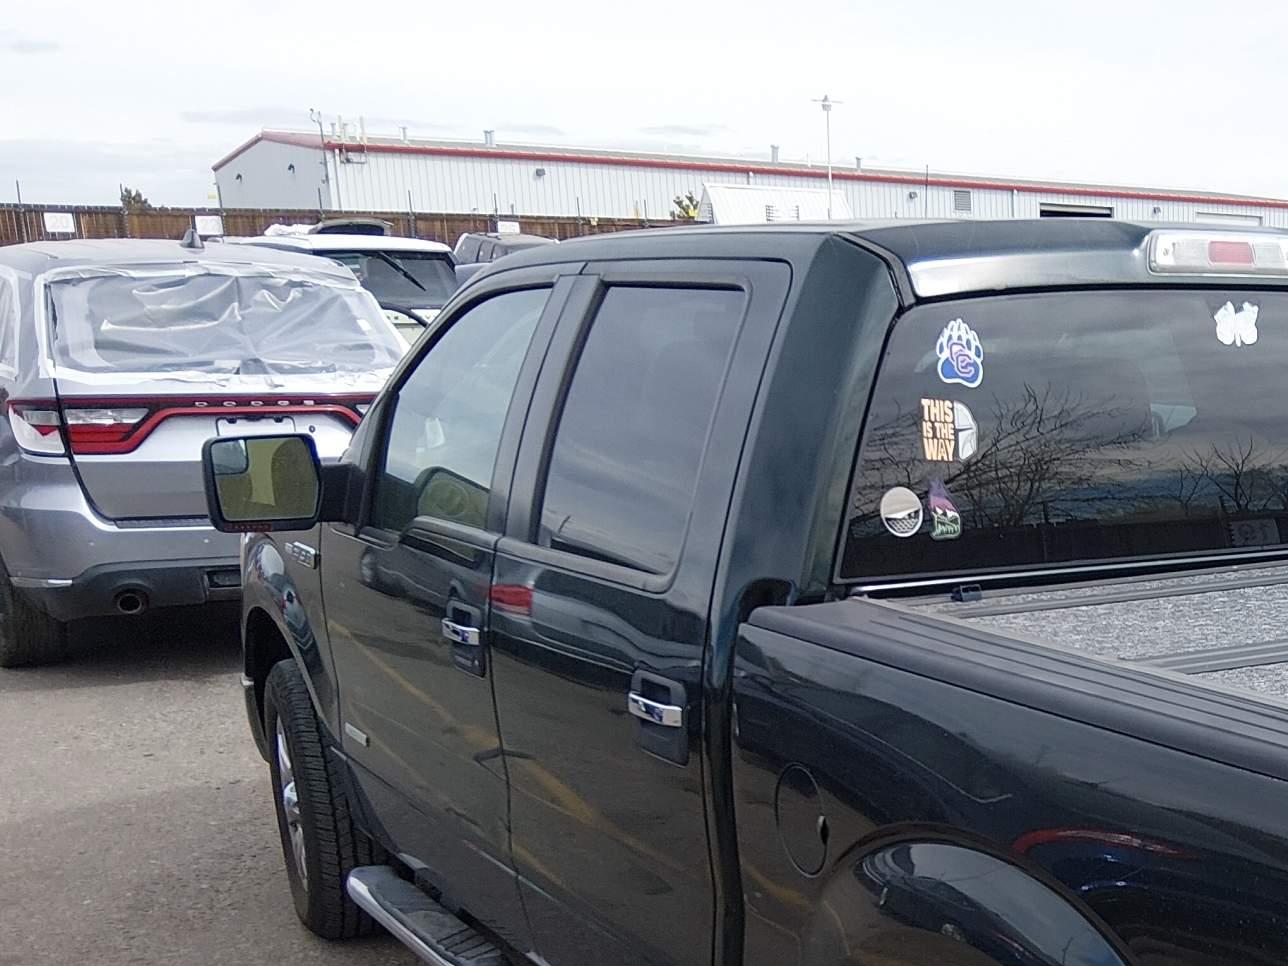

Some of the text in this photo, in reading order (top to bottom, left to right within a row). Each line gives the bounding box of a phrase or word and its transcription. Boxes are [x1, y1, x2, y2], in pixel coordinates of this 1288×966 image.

[921, 398, 953, 422] THIS
[922, 421, 955, 440] IS THE
[923, 437, 955, 461] WAY
